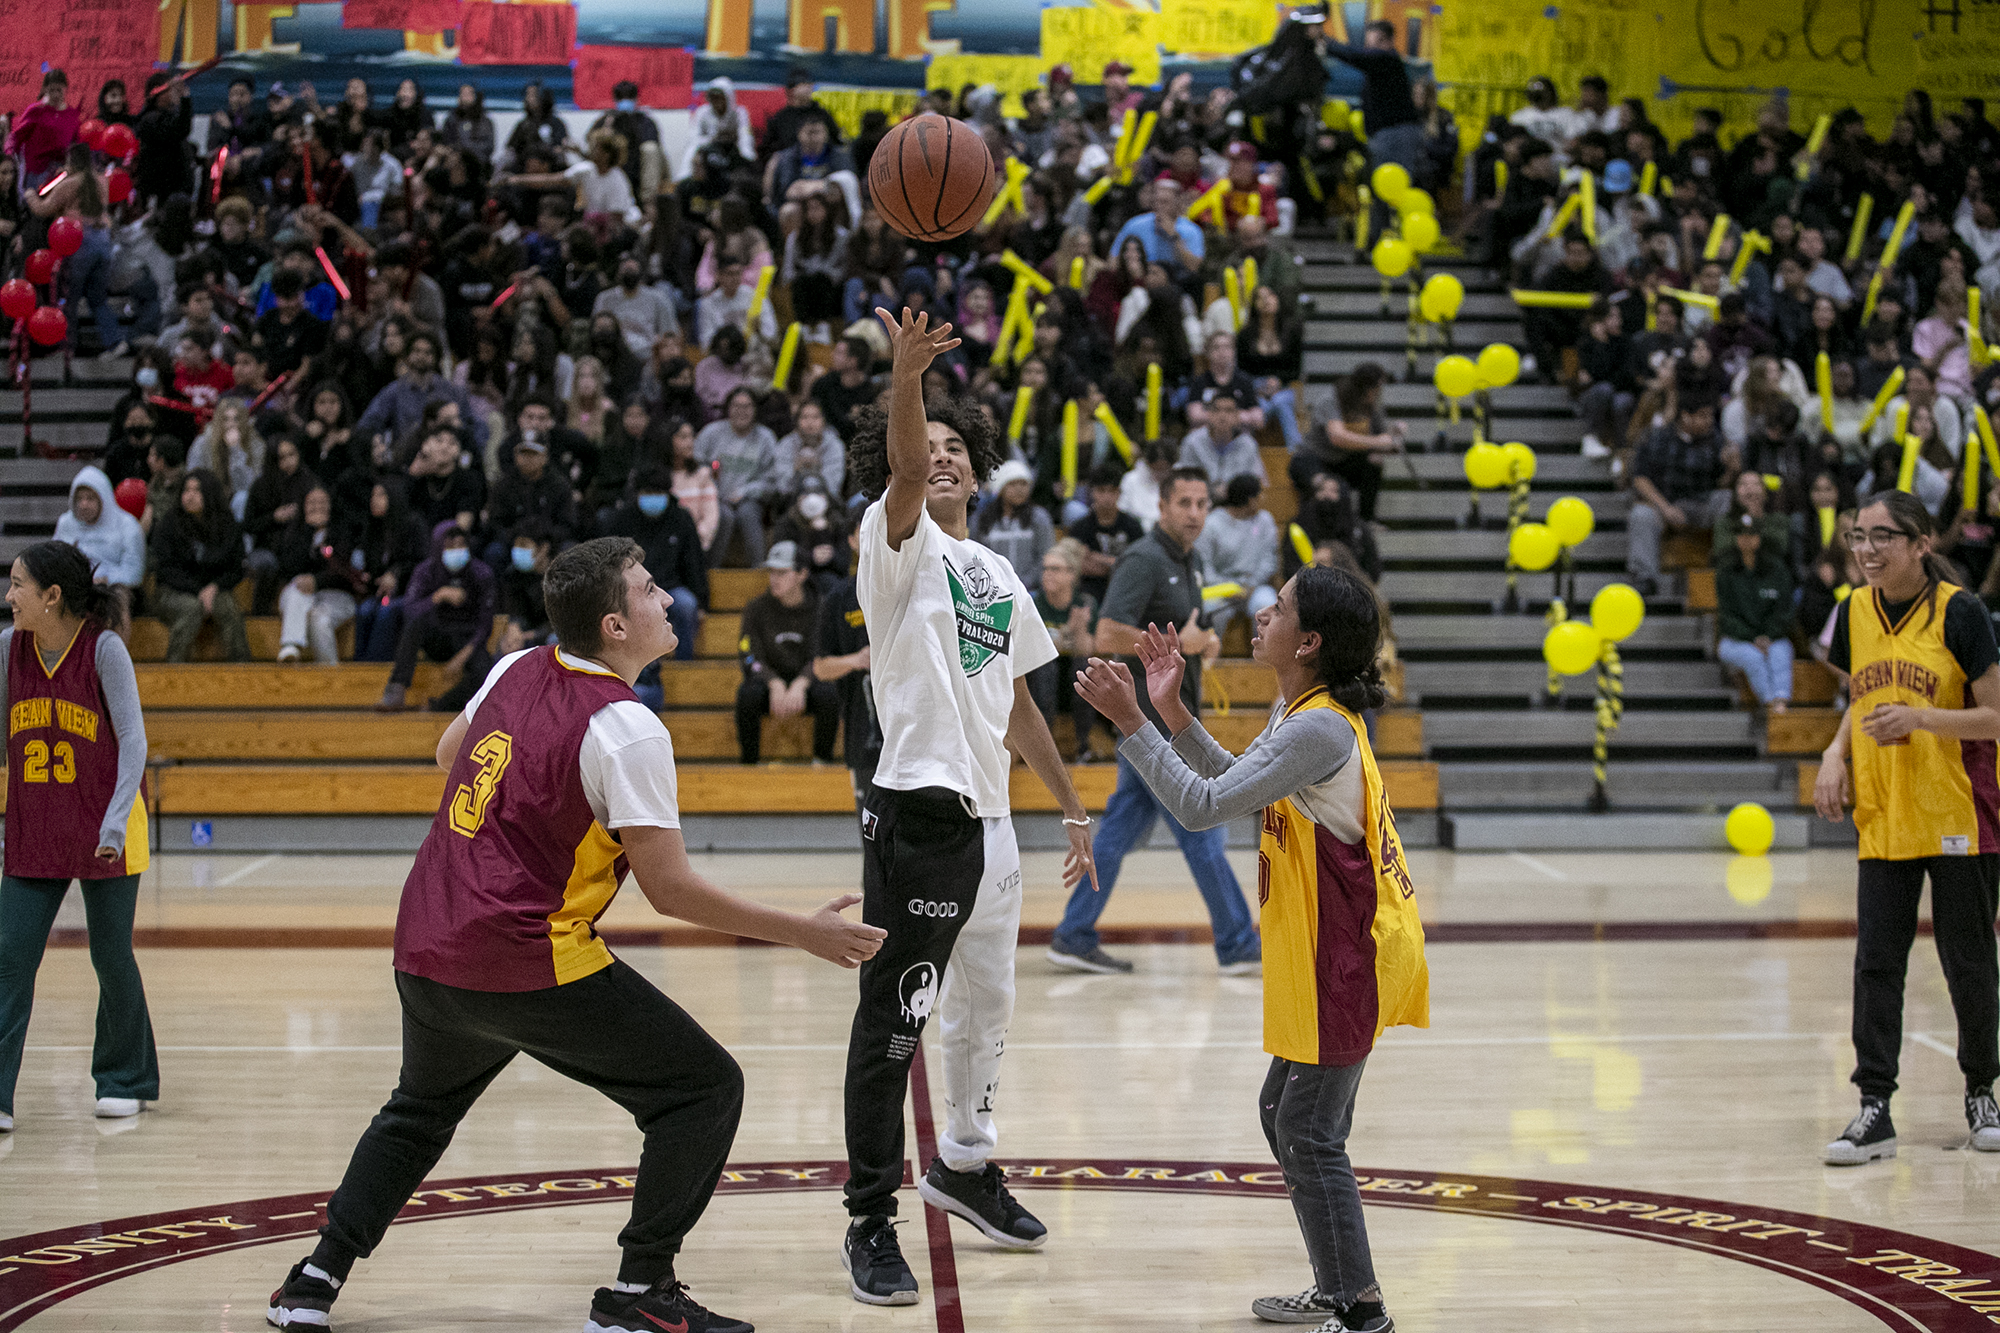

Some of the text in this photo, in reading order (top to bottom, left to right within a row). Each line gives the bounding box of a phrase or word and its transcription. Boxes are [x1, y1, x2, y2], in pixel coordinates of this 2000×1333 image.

[982, 628, 1005, 648] 2020
[55, 698, 99, 743] VIEW
[24, 739, 77, 783] 23
[449, 730, 513, 839] 3
[907, 898, 959, 918] GOOD
[0, 1216, 257, 1266] UNITY
[1542, 1196, 1825, 1241] SPIRIT
